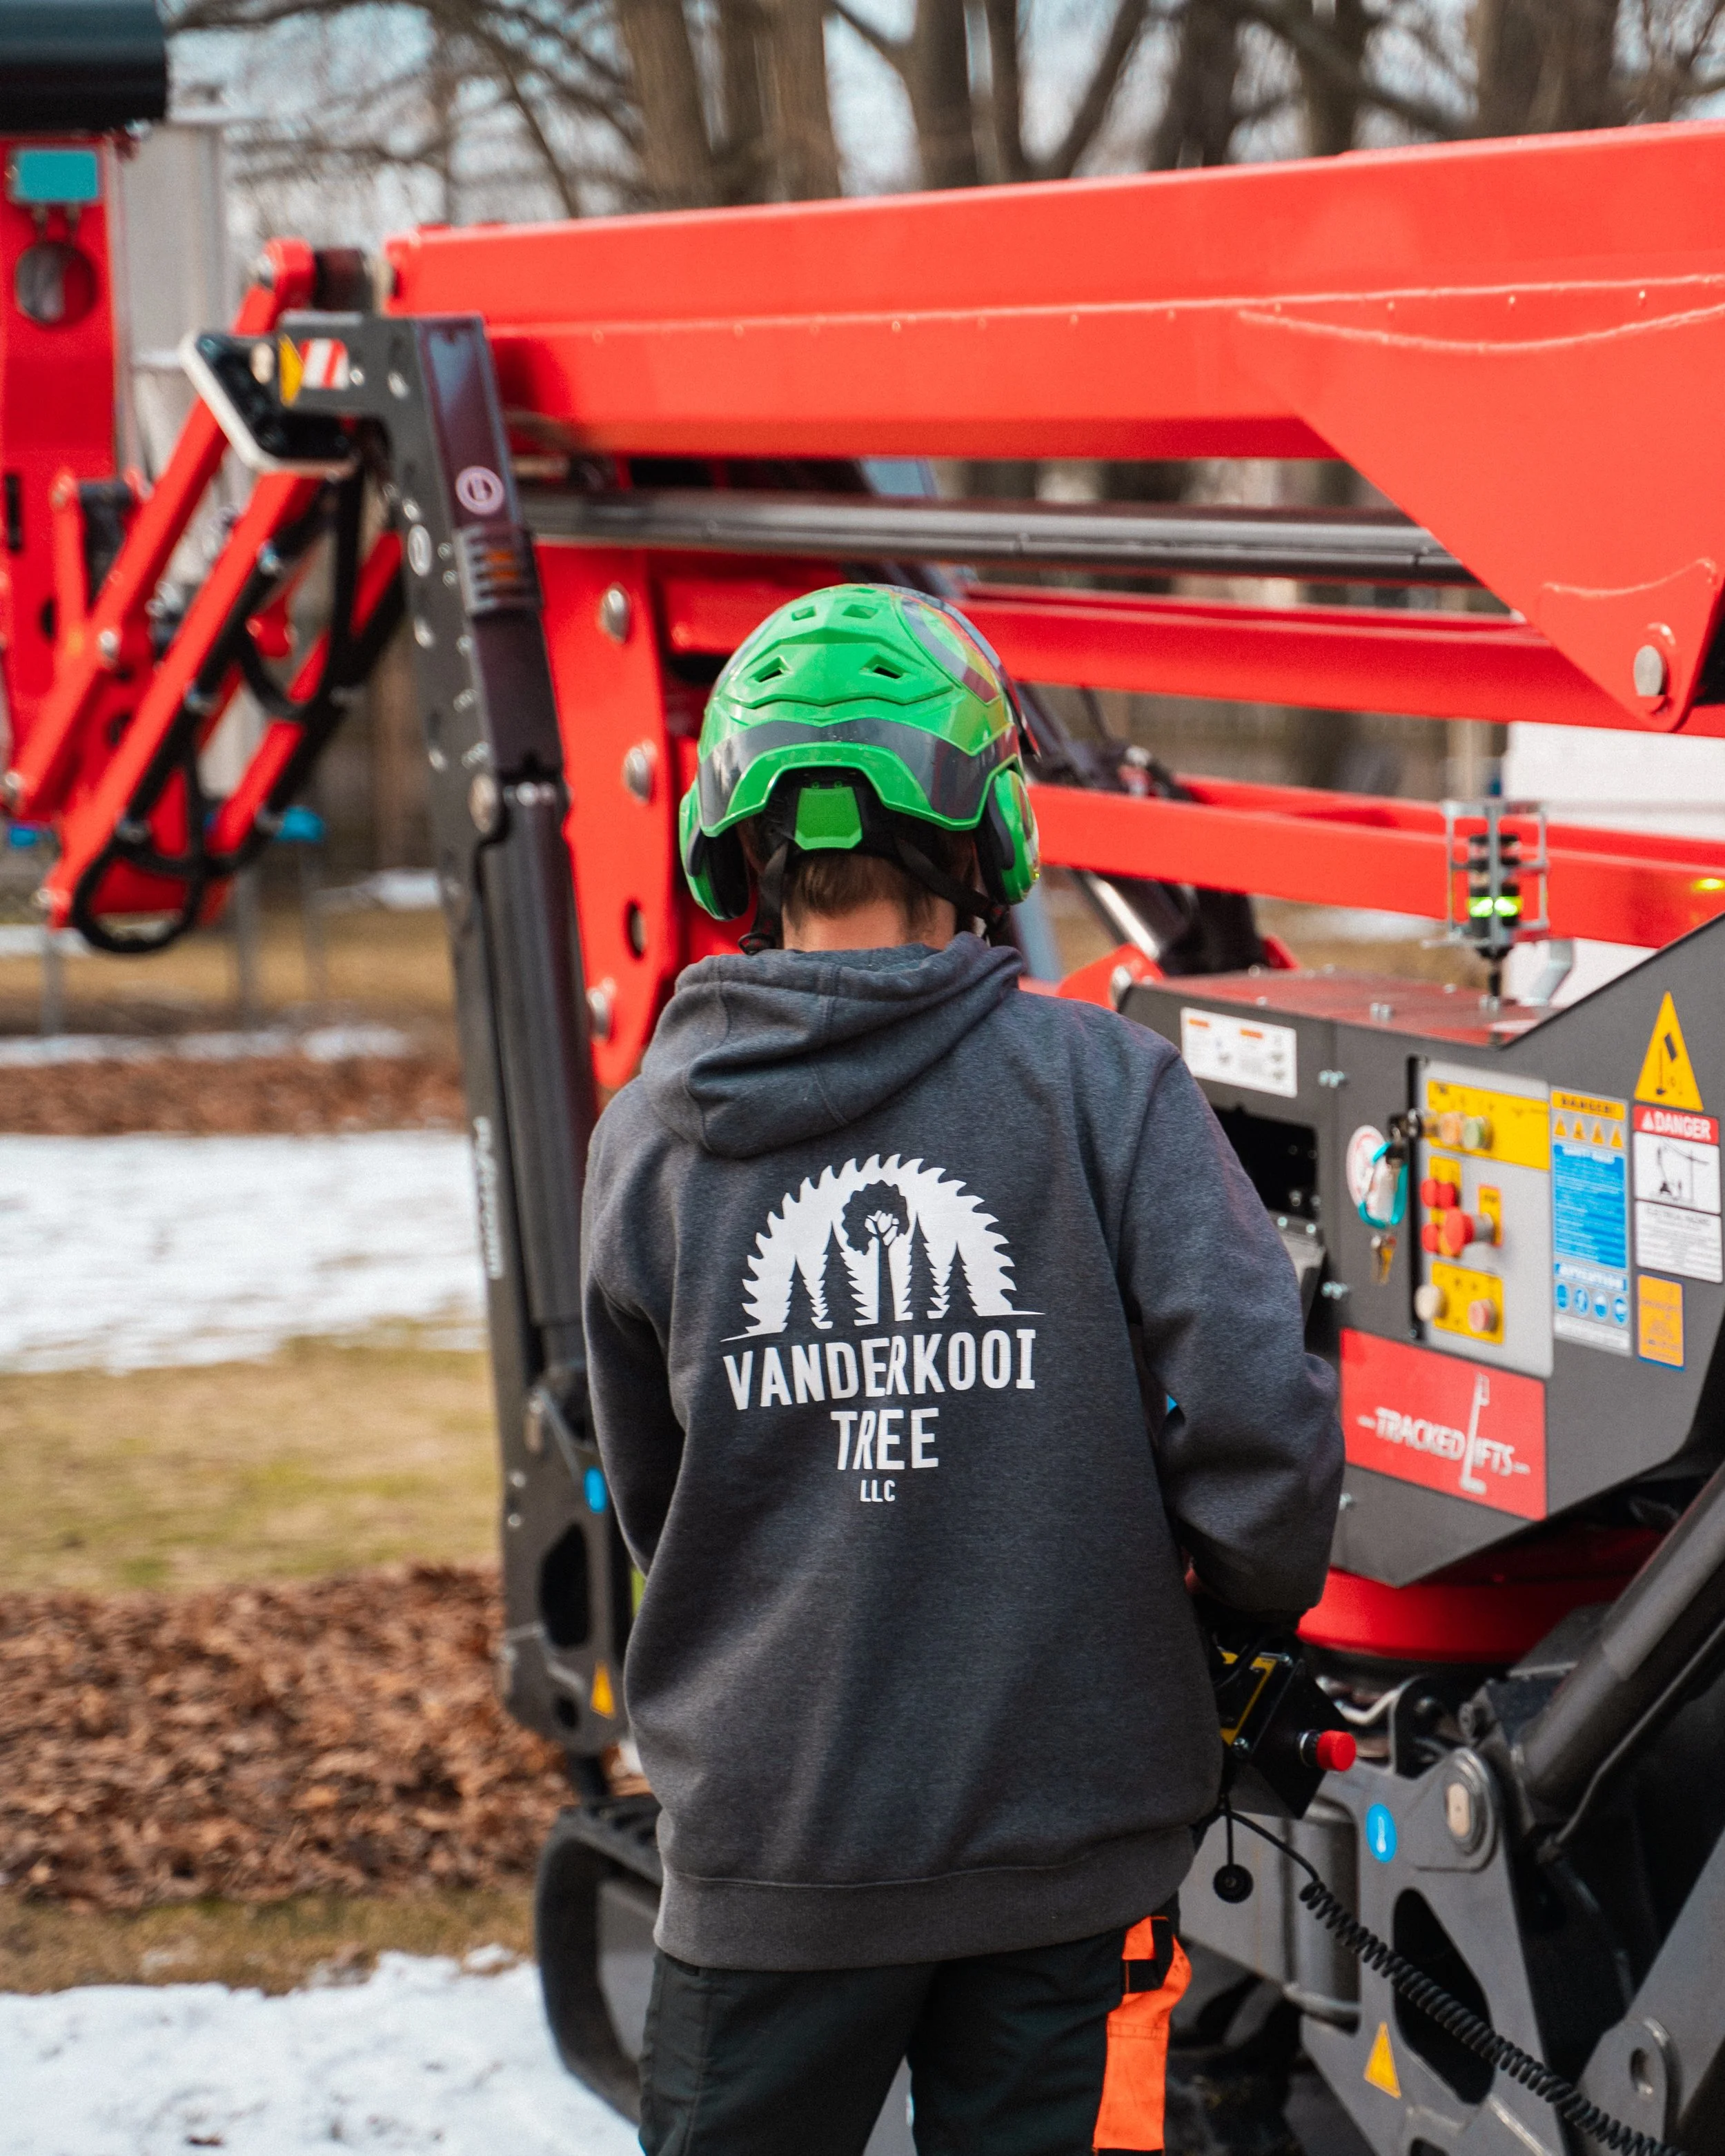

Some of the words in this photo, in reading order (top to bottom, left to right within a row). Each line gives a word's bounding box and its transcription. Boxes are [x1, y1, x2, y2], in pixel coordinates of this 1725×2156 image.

[1654, 1110, 1712, 1141] DANGER
[722, 1329, 1036, 1411] VANDERKOOI
[830, 1407, 940, 1470] TREE
[1374, 1405, 1467, 1462] TRACKED
[860, 1479, 896, 1503] LLC
